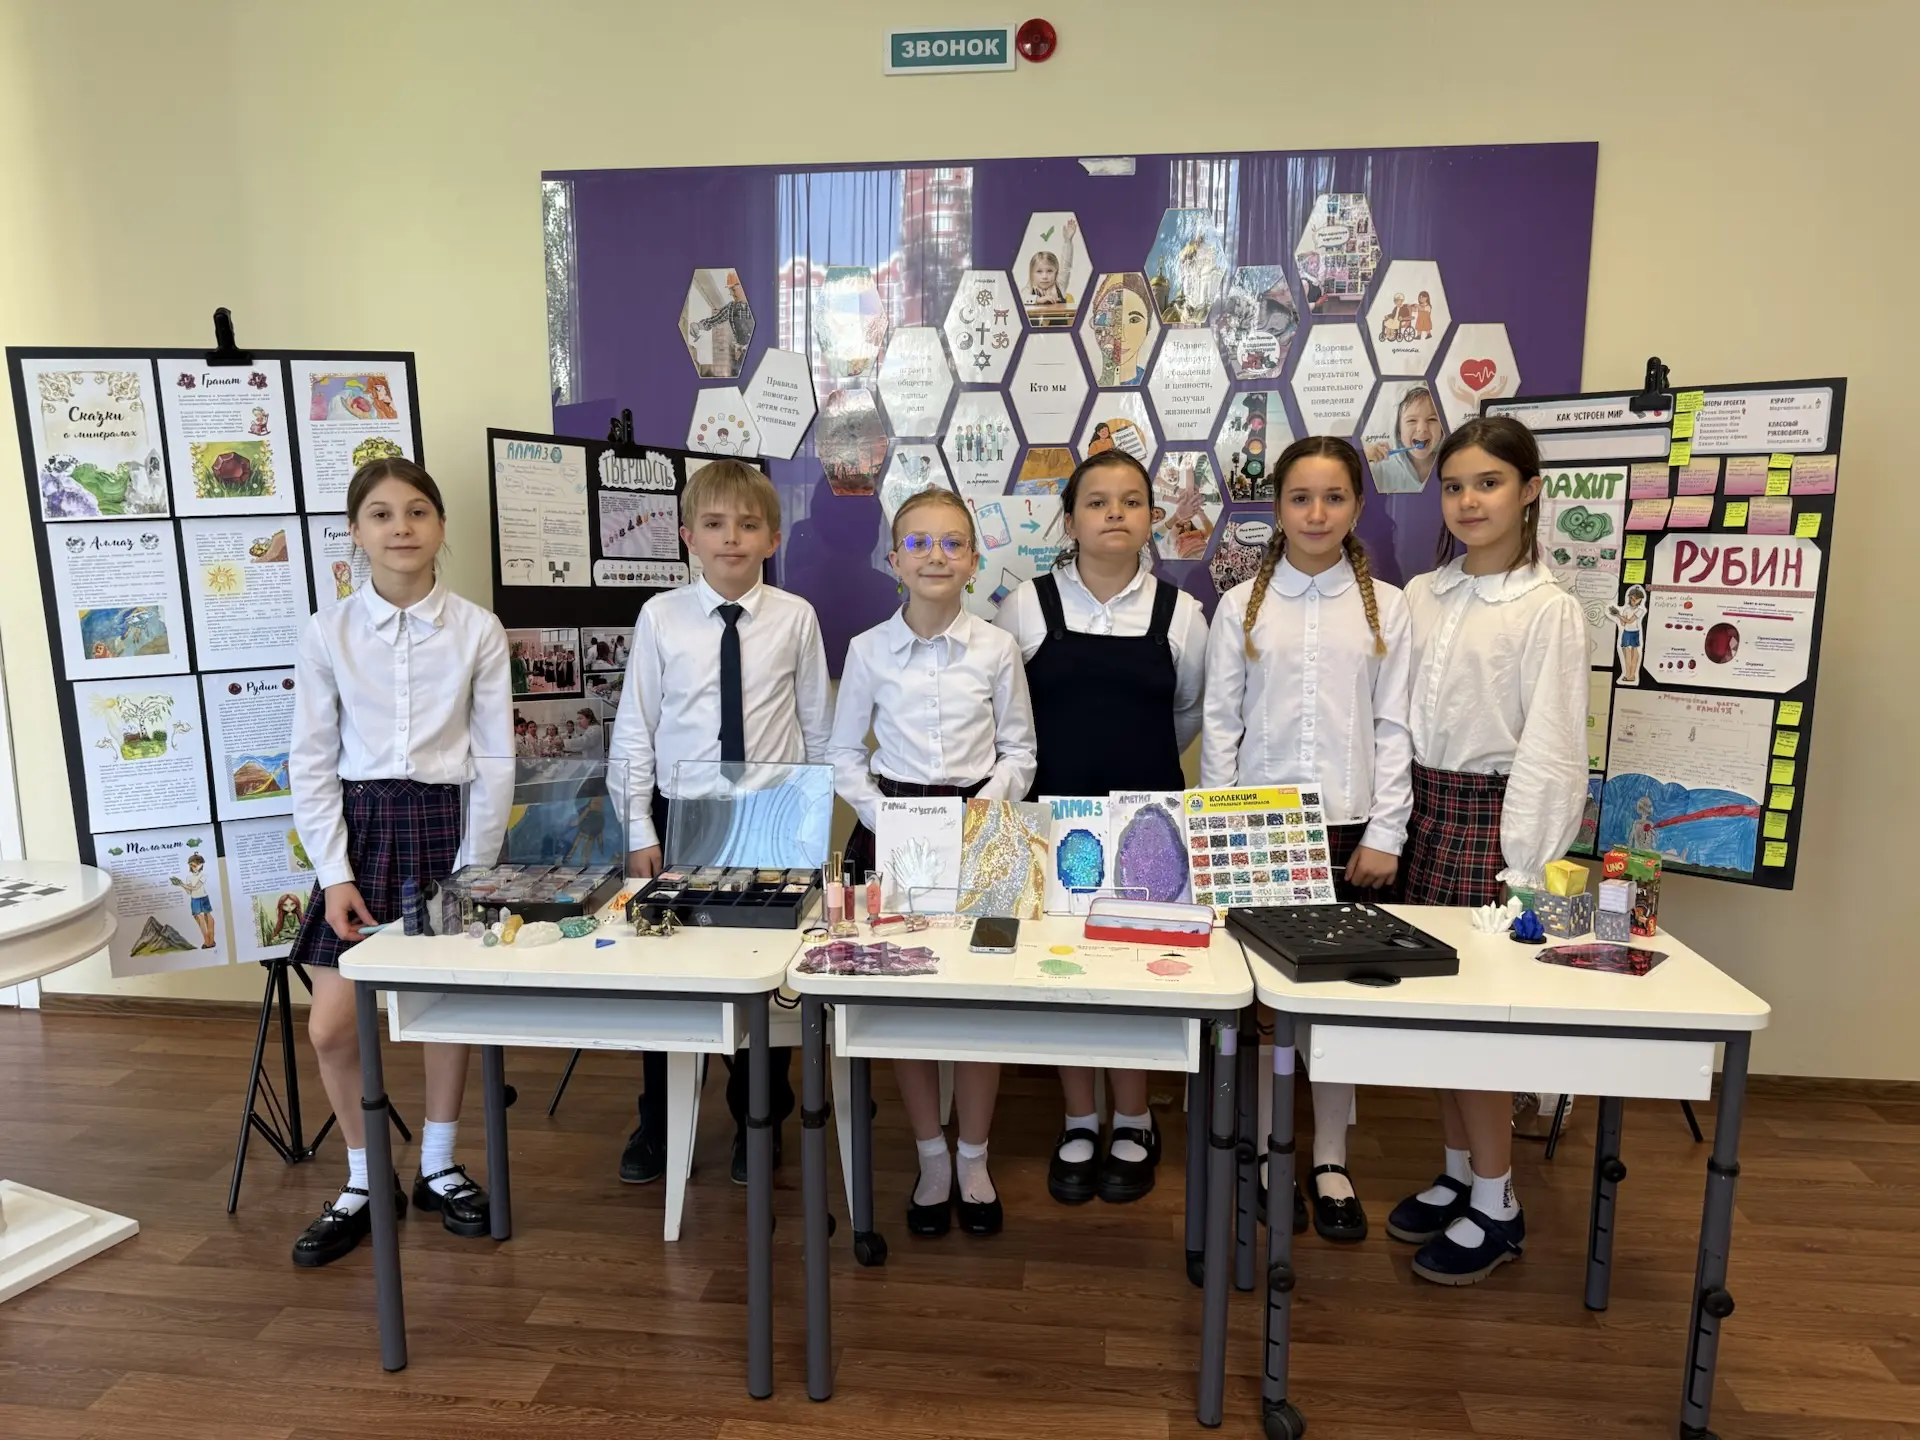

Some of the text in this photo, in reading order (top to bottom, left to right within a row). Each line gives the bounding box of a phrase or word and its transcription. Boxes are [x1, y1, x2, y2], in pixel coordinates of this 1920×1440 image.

[901, 38, 999, 58] ЗВОНОК
[1315, 343, 1354, 353] Здоровье
[201, 373, 242, 388] Гранат
[1308, 371, 1360, 381] результатом
[766, 376, 799, 390] Правила
[1030, 383, 1067, 392] Кто мы
[1303, 384, 1364, 392] сознательного
[762, 390, 798, 402] помогают
[1172, 396, 1205, 404] получая
[1311, 397, 1355, 405] поведения
[756, 402, 800, 415] детям стать
[1164, 407, 1211, 415] жизненный
[68, 406, 124, 427] Сказки
[756, 415, 797, 427] учениками
[1556, 410, 1623, 421] КАК УСТРОЕН МИР
[1768, 420, 1799, 428] КЛАССНЫЙ
[74, 430, 138, 441] минералах
[507, 442, 549, 460] АЛМАЗ
[602, 455, 674, 488] ТВЕРДОСТЬ
[1542, 472, 1624, 499] ЛАХИТ
[324, 526, 351, 541] Горны
[89, 535, 135, 550] Алмаз
[1673, 540, 1803, 588] РУБИН
[246, 680, 279, 696] Рубин
[1209, 793, 1258, 803] КОЛЛЕКЦИЯ
[126, 841, 184, 854] Малахит
[1606, 862, 1625, 873] UNO
